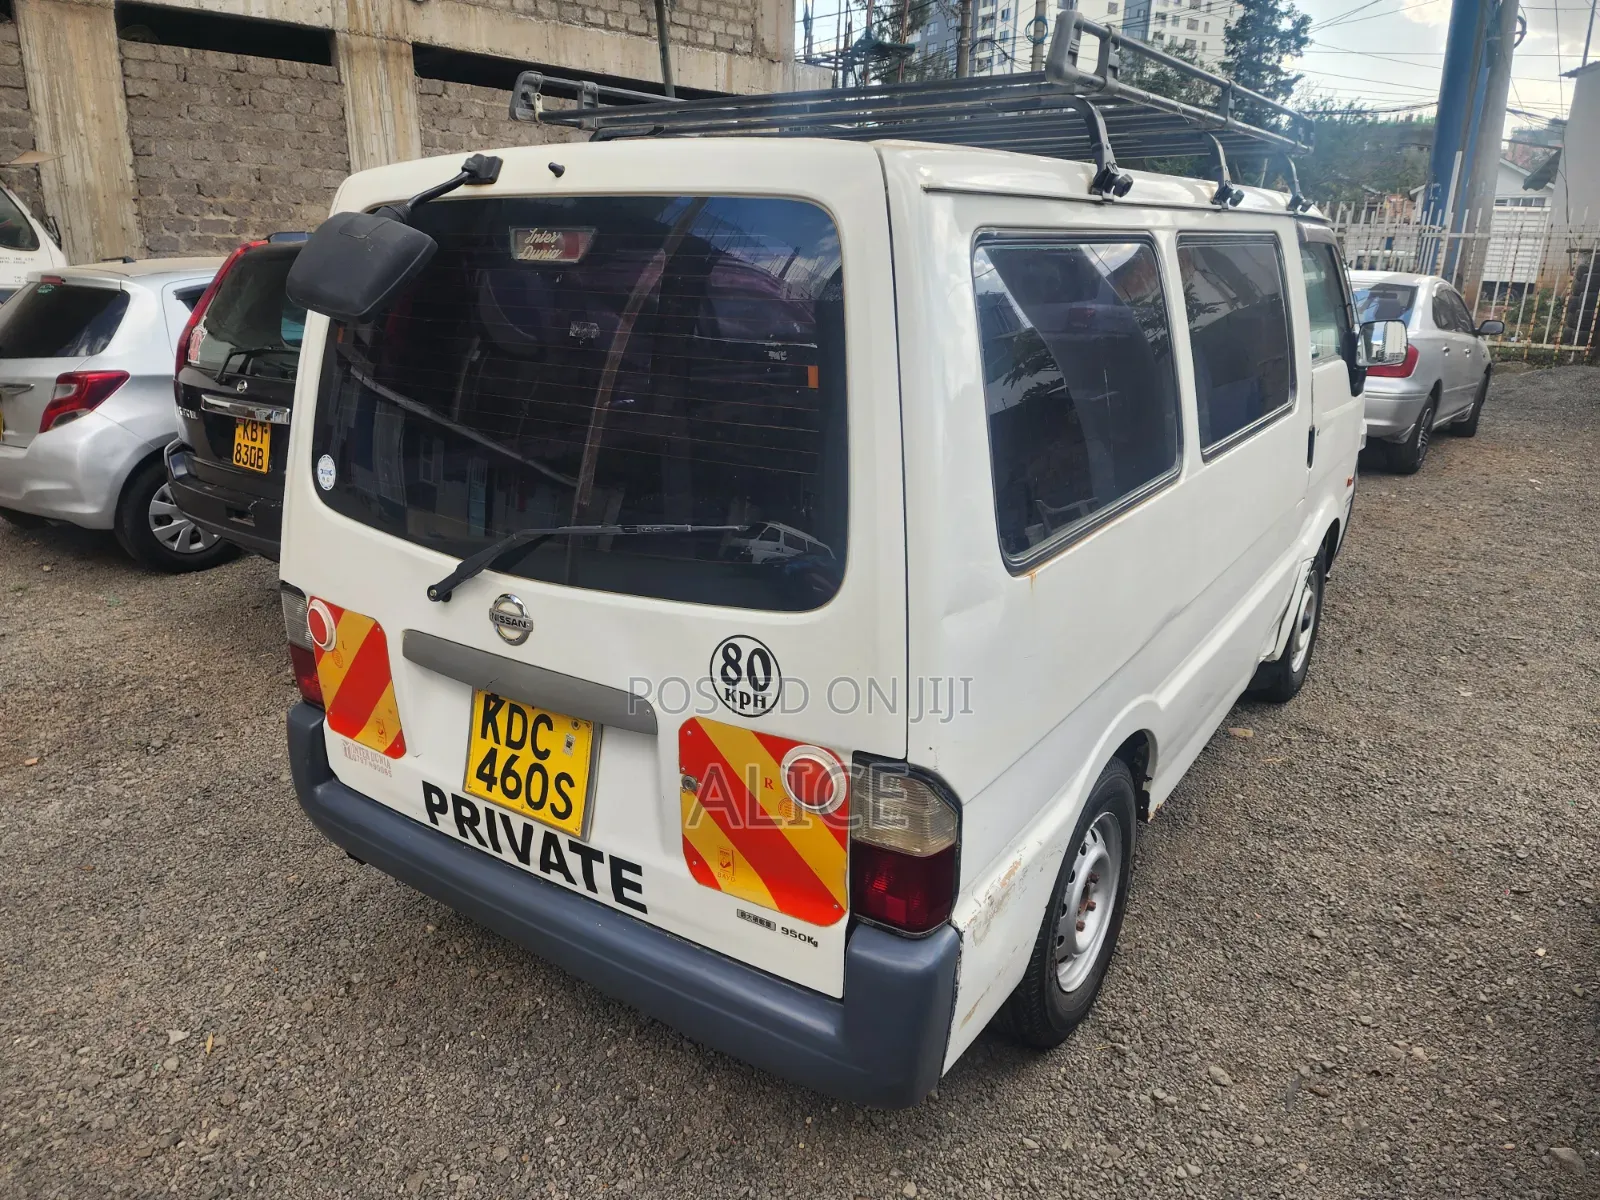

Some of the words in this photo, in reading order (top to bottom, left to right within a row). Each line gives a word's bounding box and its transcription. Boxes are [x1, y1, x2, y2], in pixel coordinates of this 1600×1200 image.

[243, 419, 266, 444] KBT
[235, 443, 264, 470] 830B
[491, 612, 527, 628] NISSAN
[720, 642, 771, 692] 80
[480, 693, 554, 761] KDC
[475, 747, 575, 820] 460S
[764, 777, 774, 790] R
[422, 780, 648, 915] PRIVATE
